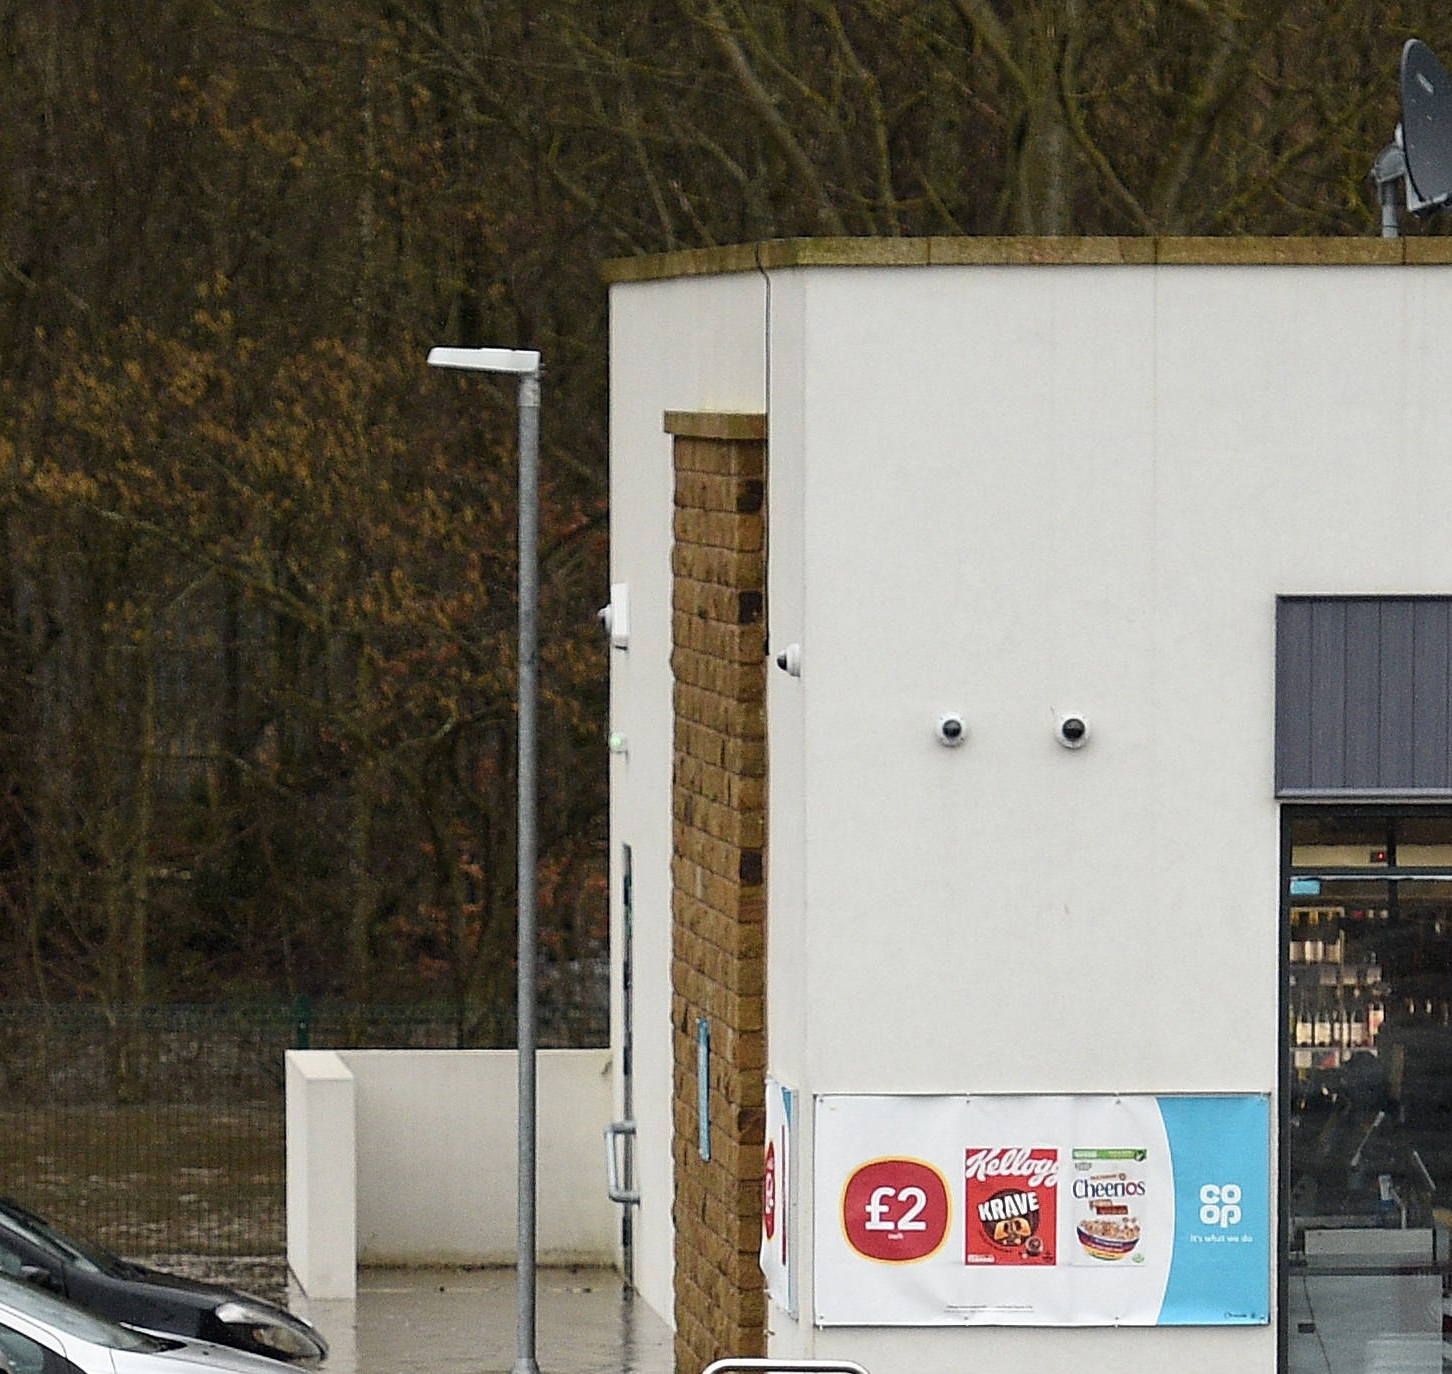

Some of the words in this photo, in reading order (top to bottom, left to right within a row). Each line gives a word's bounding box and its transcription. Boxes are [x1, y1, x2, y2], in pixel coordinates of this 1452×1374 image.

[1072, 1178, 1146, 1199] Cheerios
[864, 1186, 927, 1230] £2
[978, 1192, 1040, 1222] KRAVE
